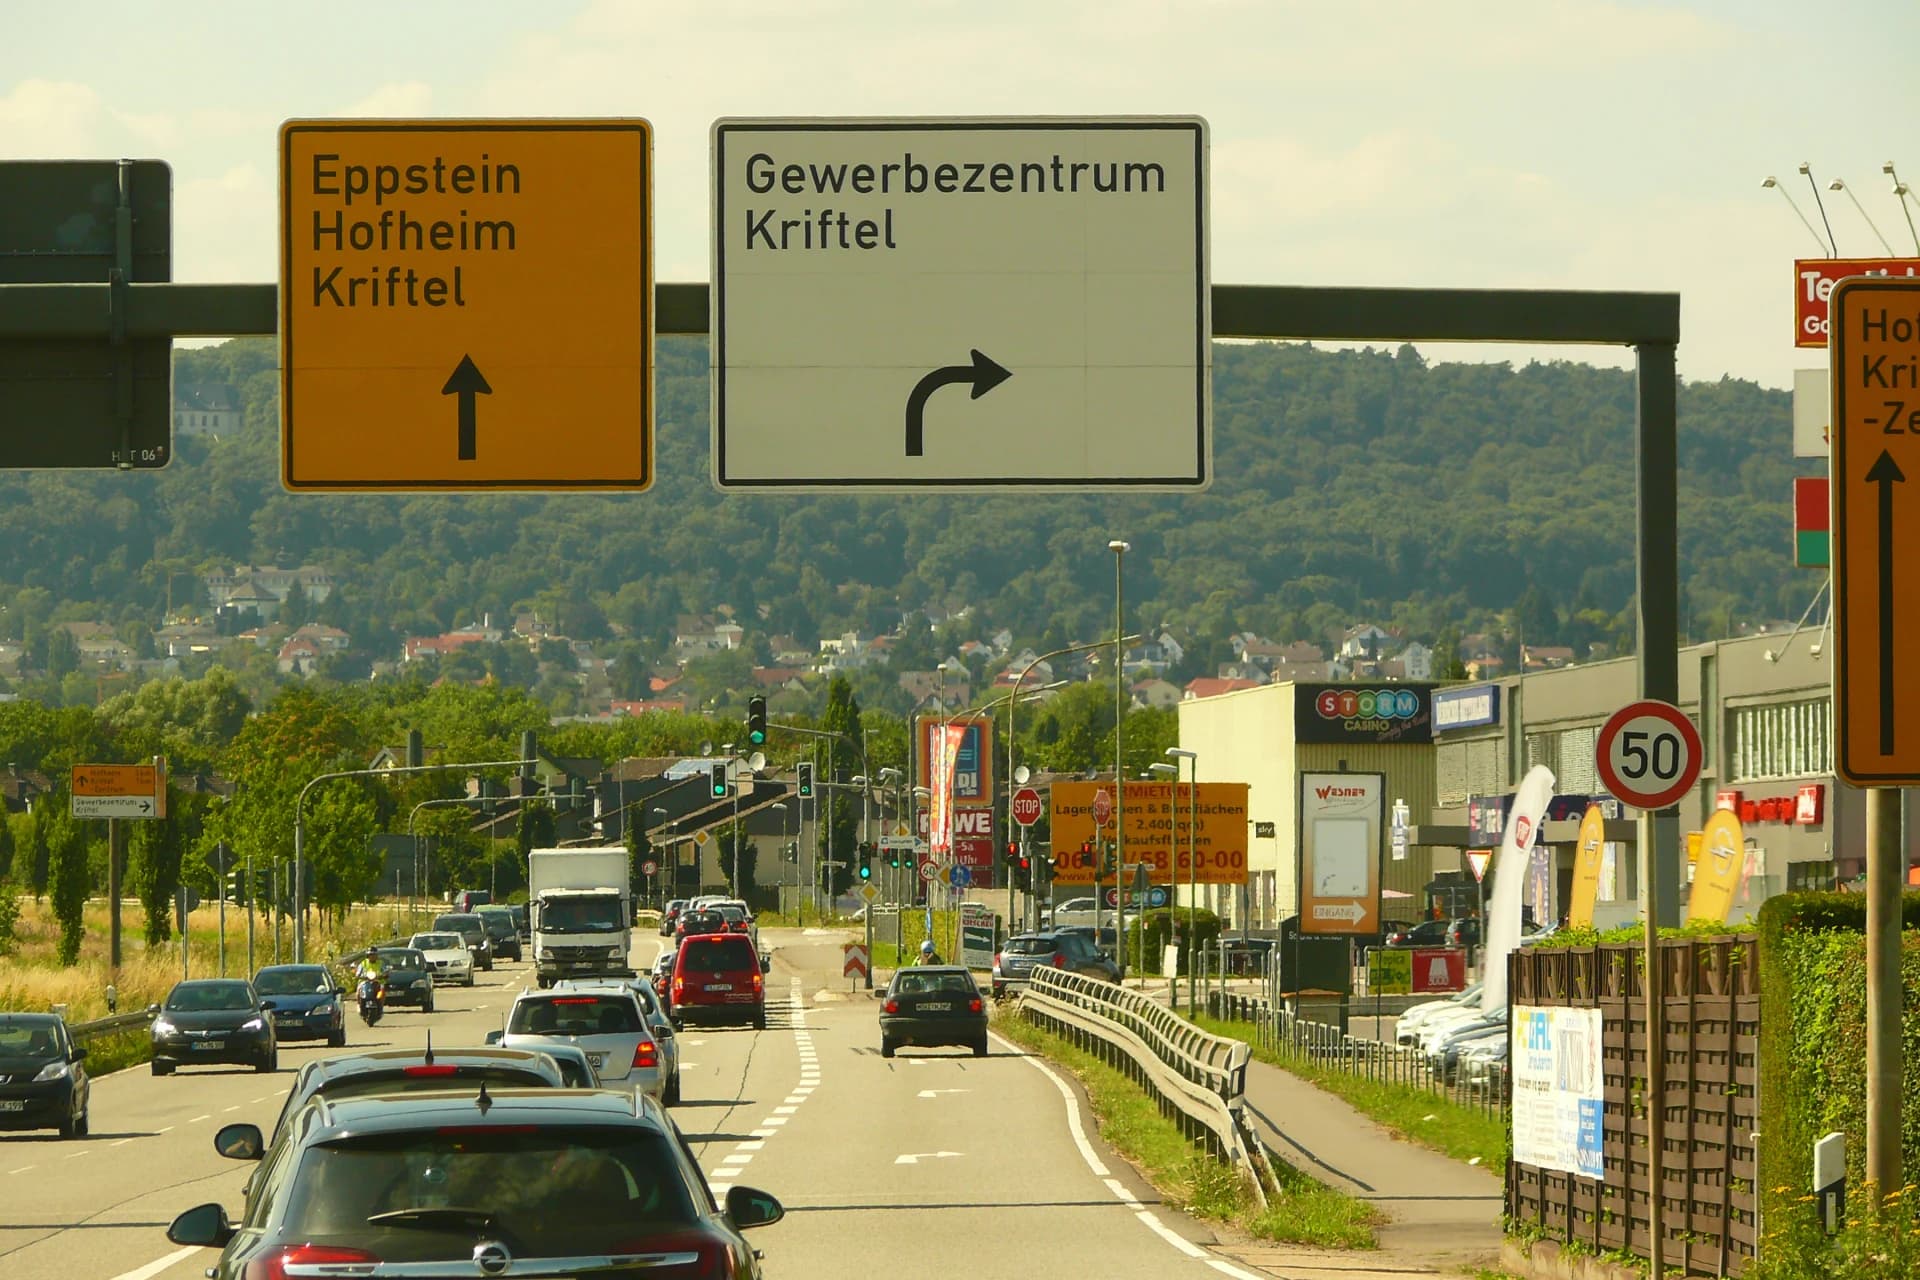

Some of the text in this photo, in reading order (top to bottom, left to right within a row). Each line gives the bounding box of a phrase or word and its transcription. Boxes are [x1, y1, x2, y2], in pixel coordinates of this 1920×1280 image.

[313, 153, 521, 206] Eppstein
[745, 153, 1166, 193] Gewerbezentrum
[313, 210, 516, 250] Hofheim
[745, 208, 897, 250] Kriftel
[313, 266, 466, 307] Kriftel
[1863, 355, 1918, 388] Kri
[1863, 401, 1920, 435] -Ze
[142, 449, 156, 461] 06
[1323, 696, 1415, 713] STORM
[1344, 720, 1390, 731] CASINO
[1621, 731, 1680, 780] 50
[1014, 799, 1039, 815] STOP
[1136, 819, 1173, 831] 2.400
[1257, 825, 1273, 835] sky
[959, 857, 977, 865] Uhr
